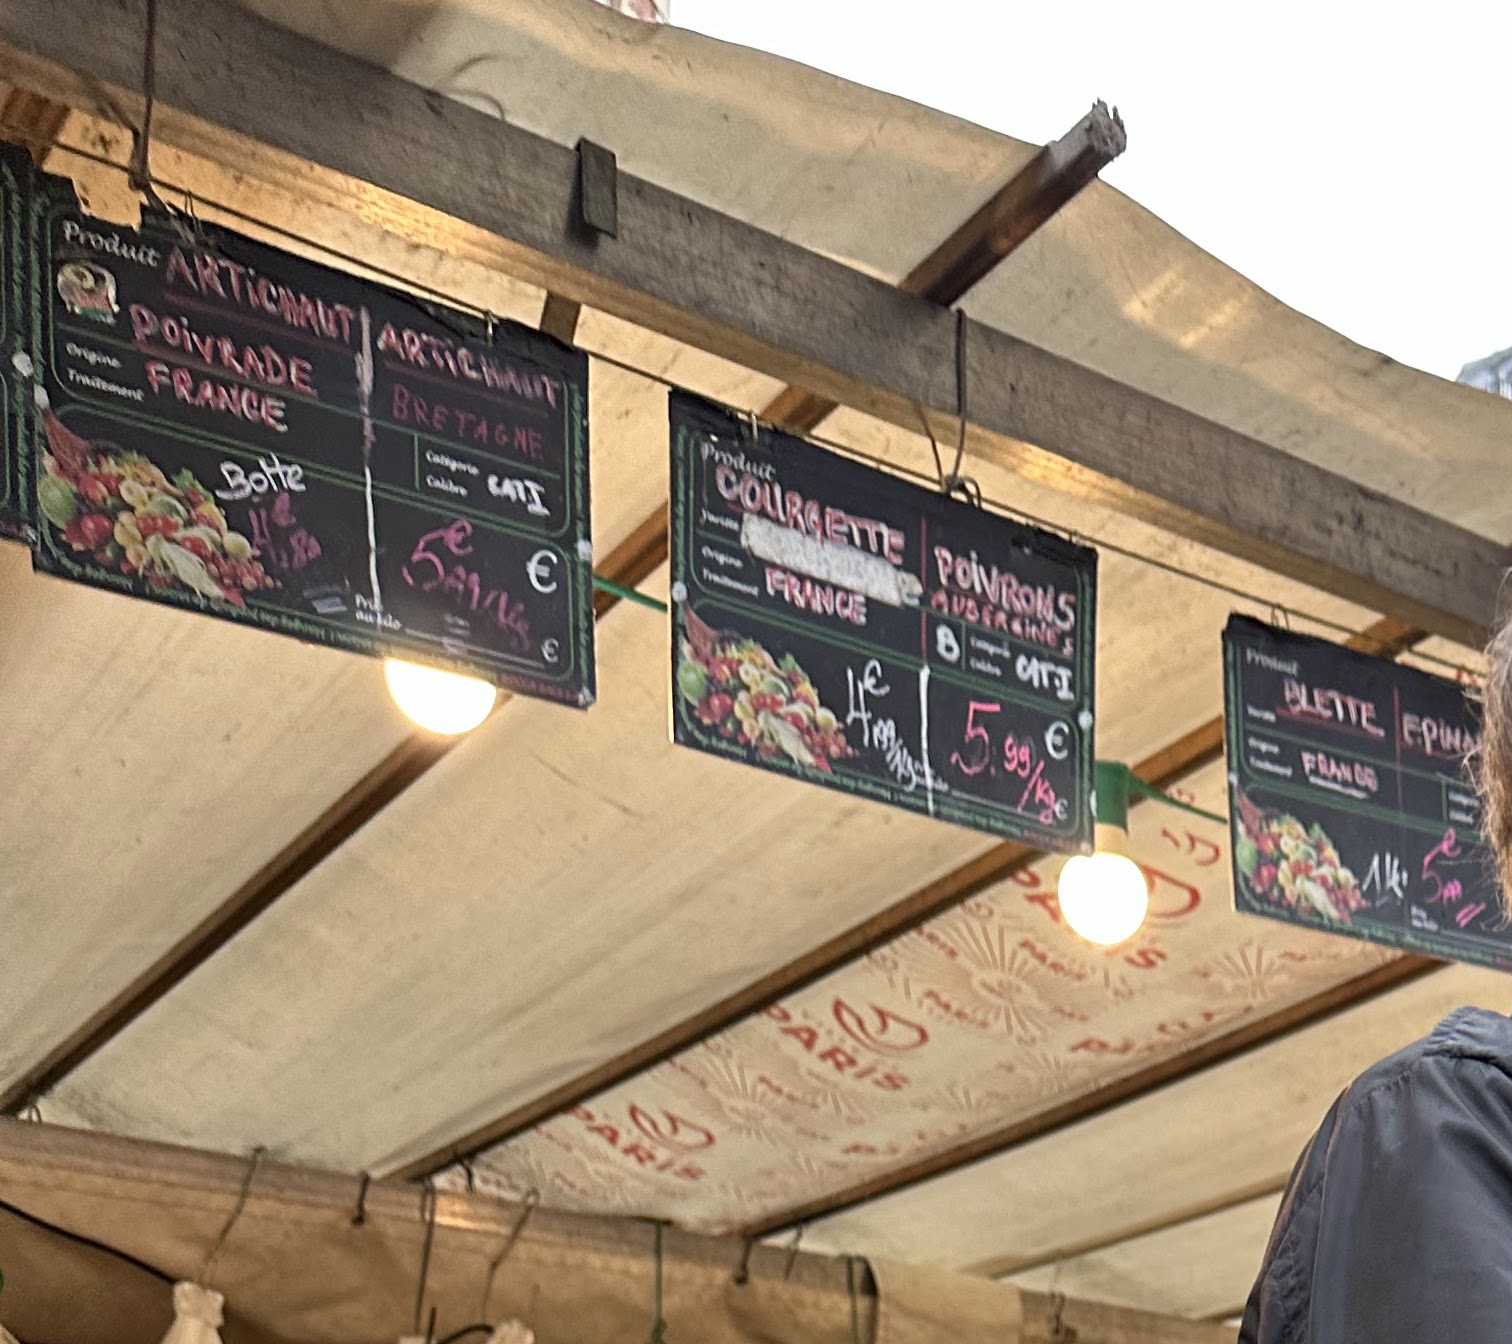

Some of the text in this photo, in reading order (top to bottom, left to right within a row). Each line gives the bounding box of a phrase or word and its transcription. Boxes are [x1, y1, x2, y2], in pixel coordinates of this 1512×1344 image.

[62, 219, 161, 267] Produit
[145, 360, 288, 432] FRANCE
[391, 383, 543, 460] BRETAGNE
[701, 441, 776, 482] Produit
[715, 463, 905, 565] COURGETTE
[765, 566, 867, 626] FRANCE
